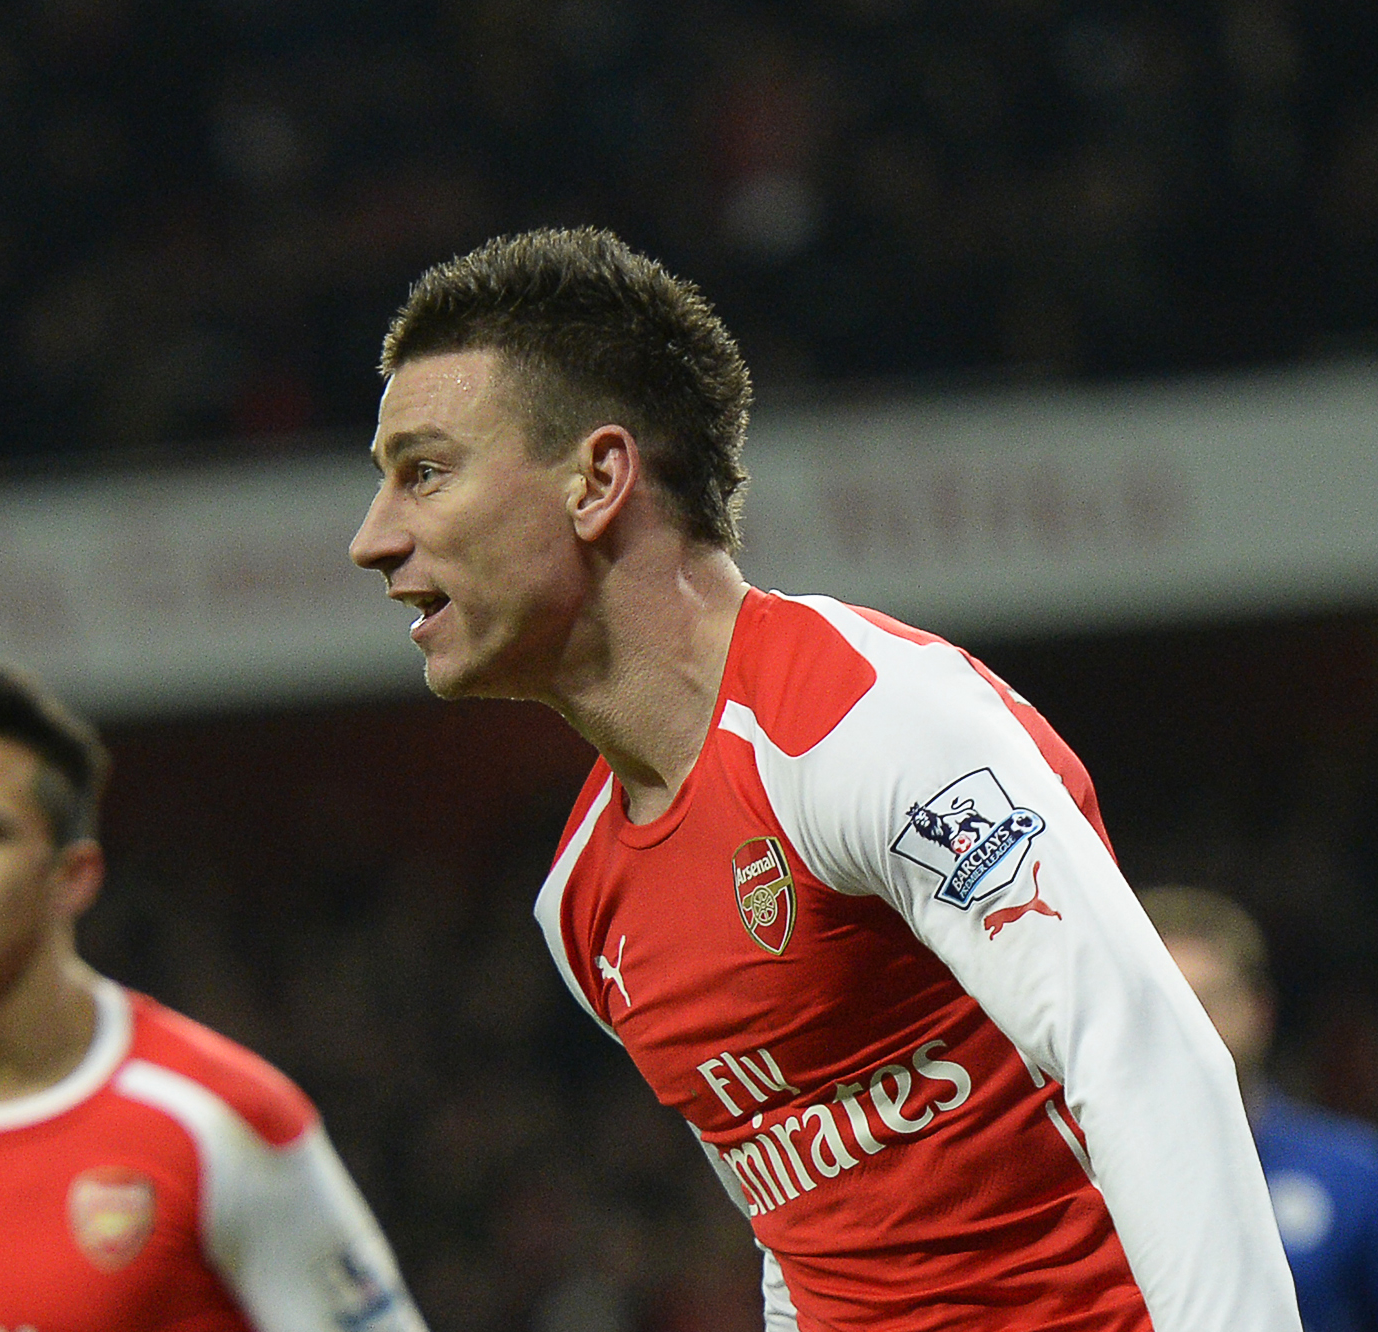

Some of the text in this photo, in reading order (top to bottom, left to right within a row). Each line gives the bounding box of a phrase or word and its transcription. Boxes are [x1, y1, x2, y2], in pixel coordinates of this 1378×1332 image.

[736, 850, 777, 887] Arsenal
[951, 825, 1010, 892] BARCLAYS
[985, 834, 1017, 867] LEAGUE
[697, 1048, 801, 1117] Fly
[723, 1039, 972, 1216] mirates
